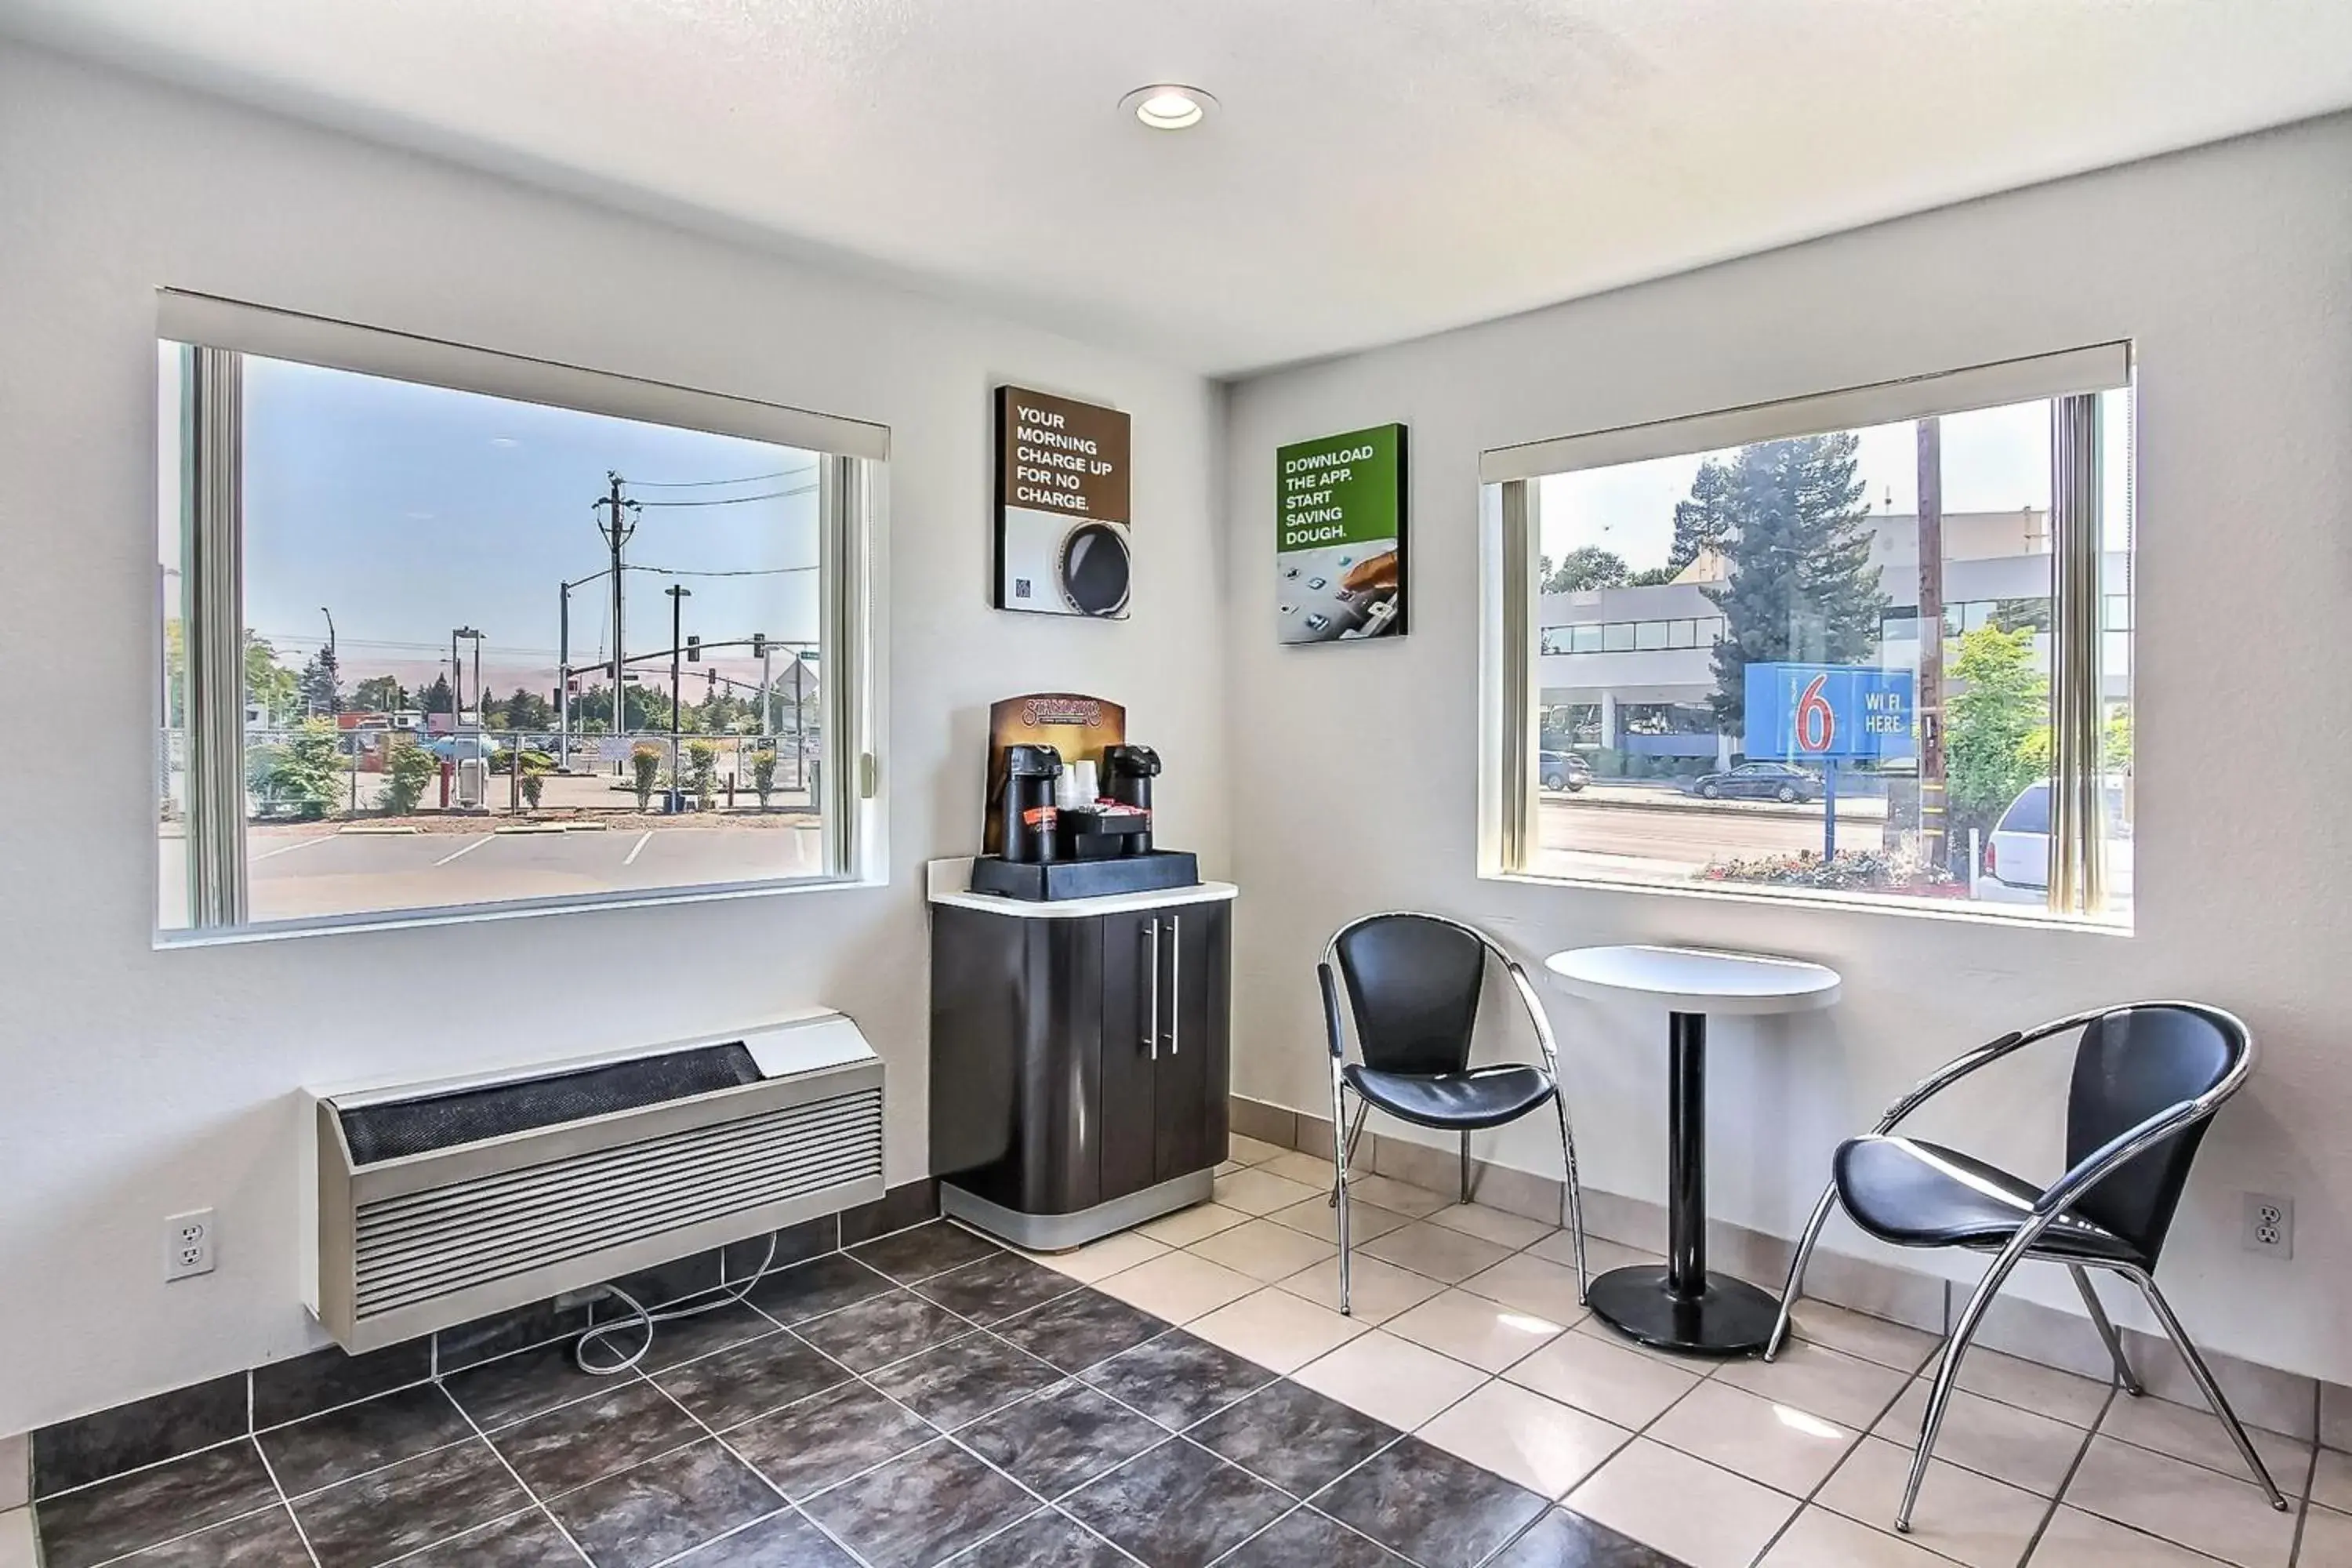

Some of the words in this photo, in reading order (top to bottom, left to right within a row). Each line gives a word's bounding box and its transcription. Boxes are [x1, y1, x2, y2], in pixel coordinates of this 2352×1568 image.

[1017, 405, 1065, 429] YOUR
[1017, 426, 1097, 455] MORNING
[1017, 446, 1086, 472] CHARGE
[1091, 460, 1112, 476] UP
[1287, 445, 1374, 474] DOWNLOAD
[1017, 466, 1051, 485] FOR
[1056, 473, 1080, 490] NO
[1286, 474, 1316, 491] THE
[1319, 468, 1352, 486] APP.
[1017, 486, 1089, 510] CHARGE.
[1287, 490, 1332, 510] START
[1286, 506, 1343, 527] SAVING
[1287, 524, 1347, 545] DOUGH.
[1795, 673, 1835, 753] 6
[1866, 715, 1901, 732] HERE
